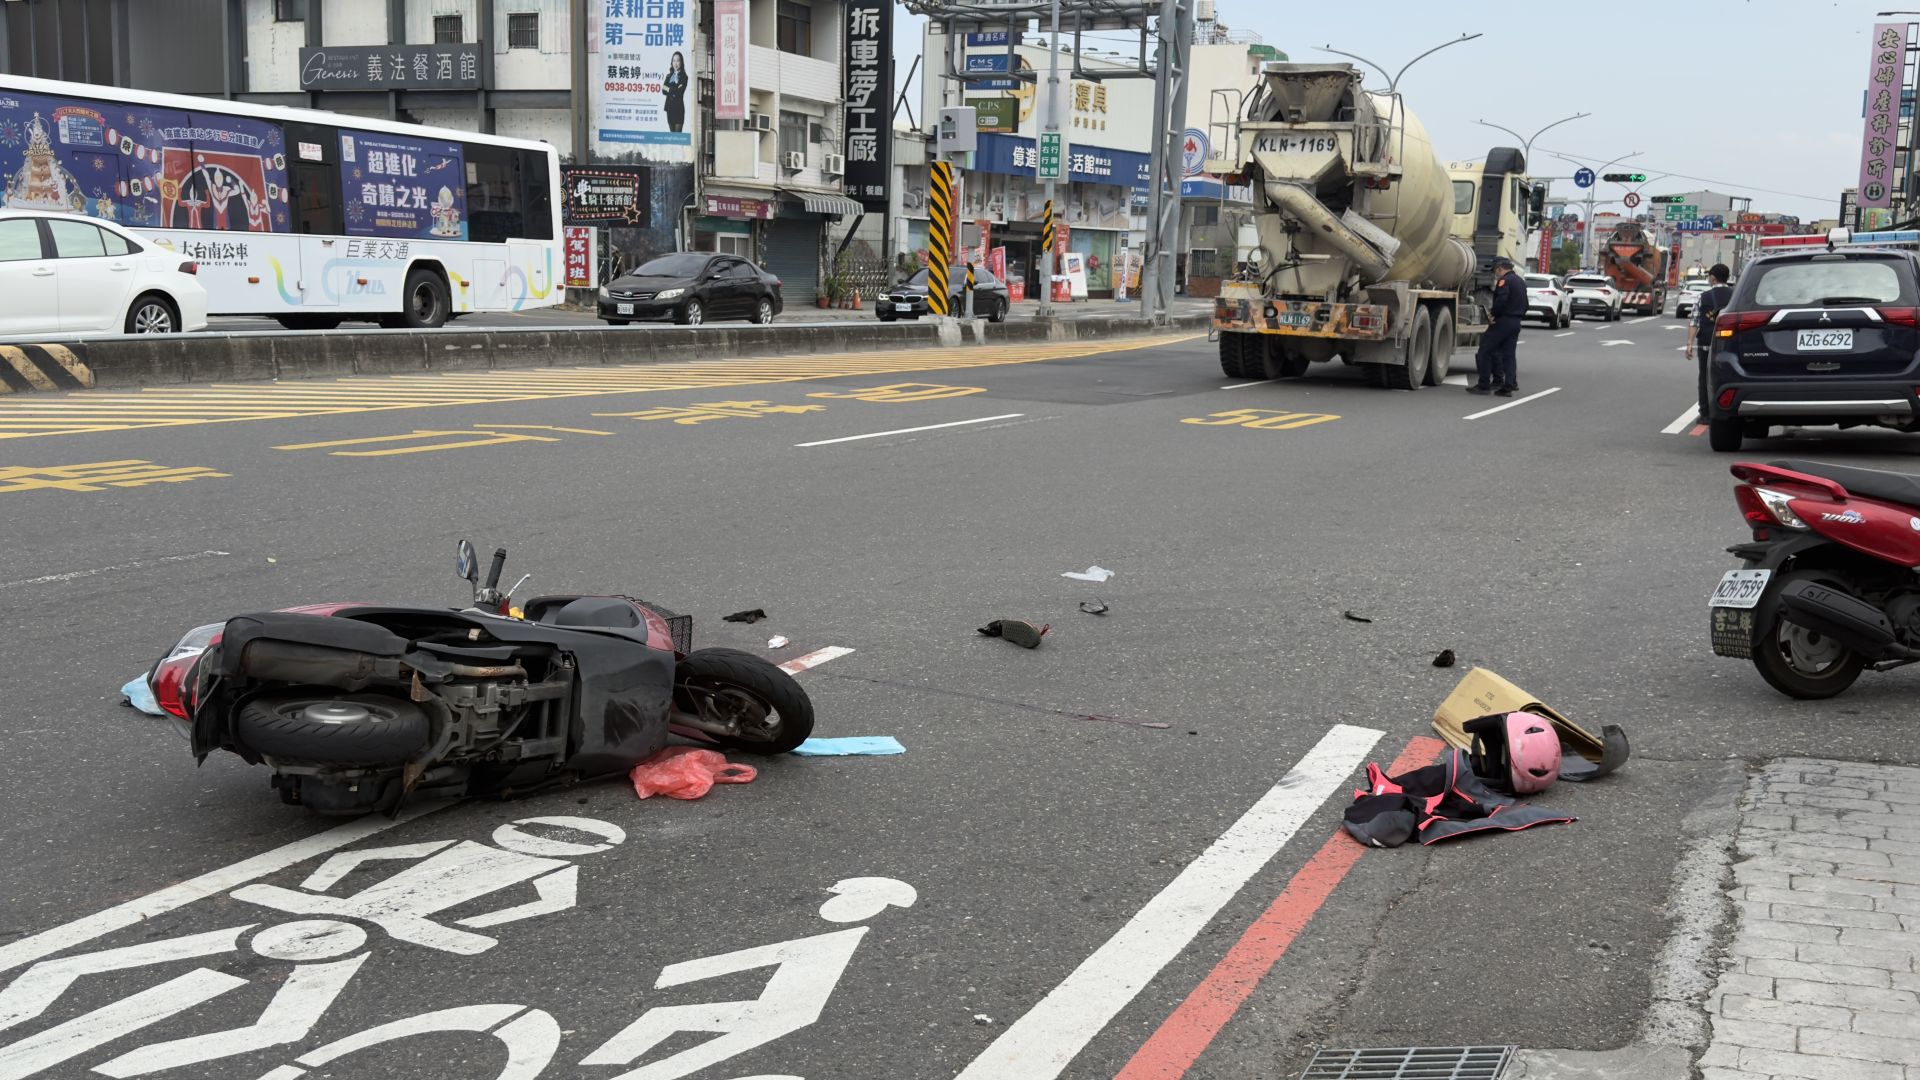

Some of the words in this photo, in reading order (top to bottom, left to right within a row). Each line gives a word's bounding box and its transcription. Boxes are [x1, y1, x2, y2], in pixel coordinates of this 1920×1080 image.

[605, 22, 684, 46] 第一品牌
[302, 52, 359, 84] Genesis
[367, 52, 476, 81] 義法餐酒館
[607, 66, 641, 79] 蔡婉婷
[642, 72, 665, 80] (Miffy)
[604, 82, 660, 93] 0938-039-760
[846, 8, 880, 162] 拆車夢工廠
[1866, 29, 1900, 179] 安心婦產科診所
[1258, 138, 1336, 152] KLN-1169
[368, 151, 417, 177] 超進化
[362, 182, 427, 209] 奇蹟之光
[181, 241, 248, 260] 大台南公車
[346, 240, 408, 259] 巨業交通
[1799, 333, 1851, 347] AZG-6292
[806, 383, 988, 402] 50
[1179, 408, 1342, 430] 50
[1713, 580, 1764, 598] MZH-7599
